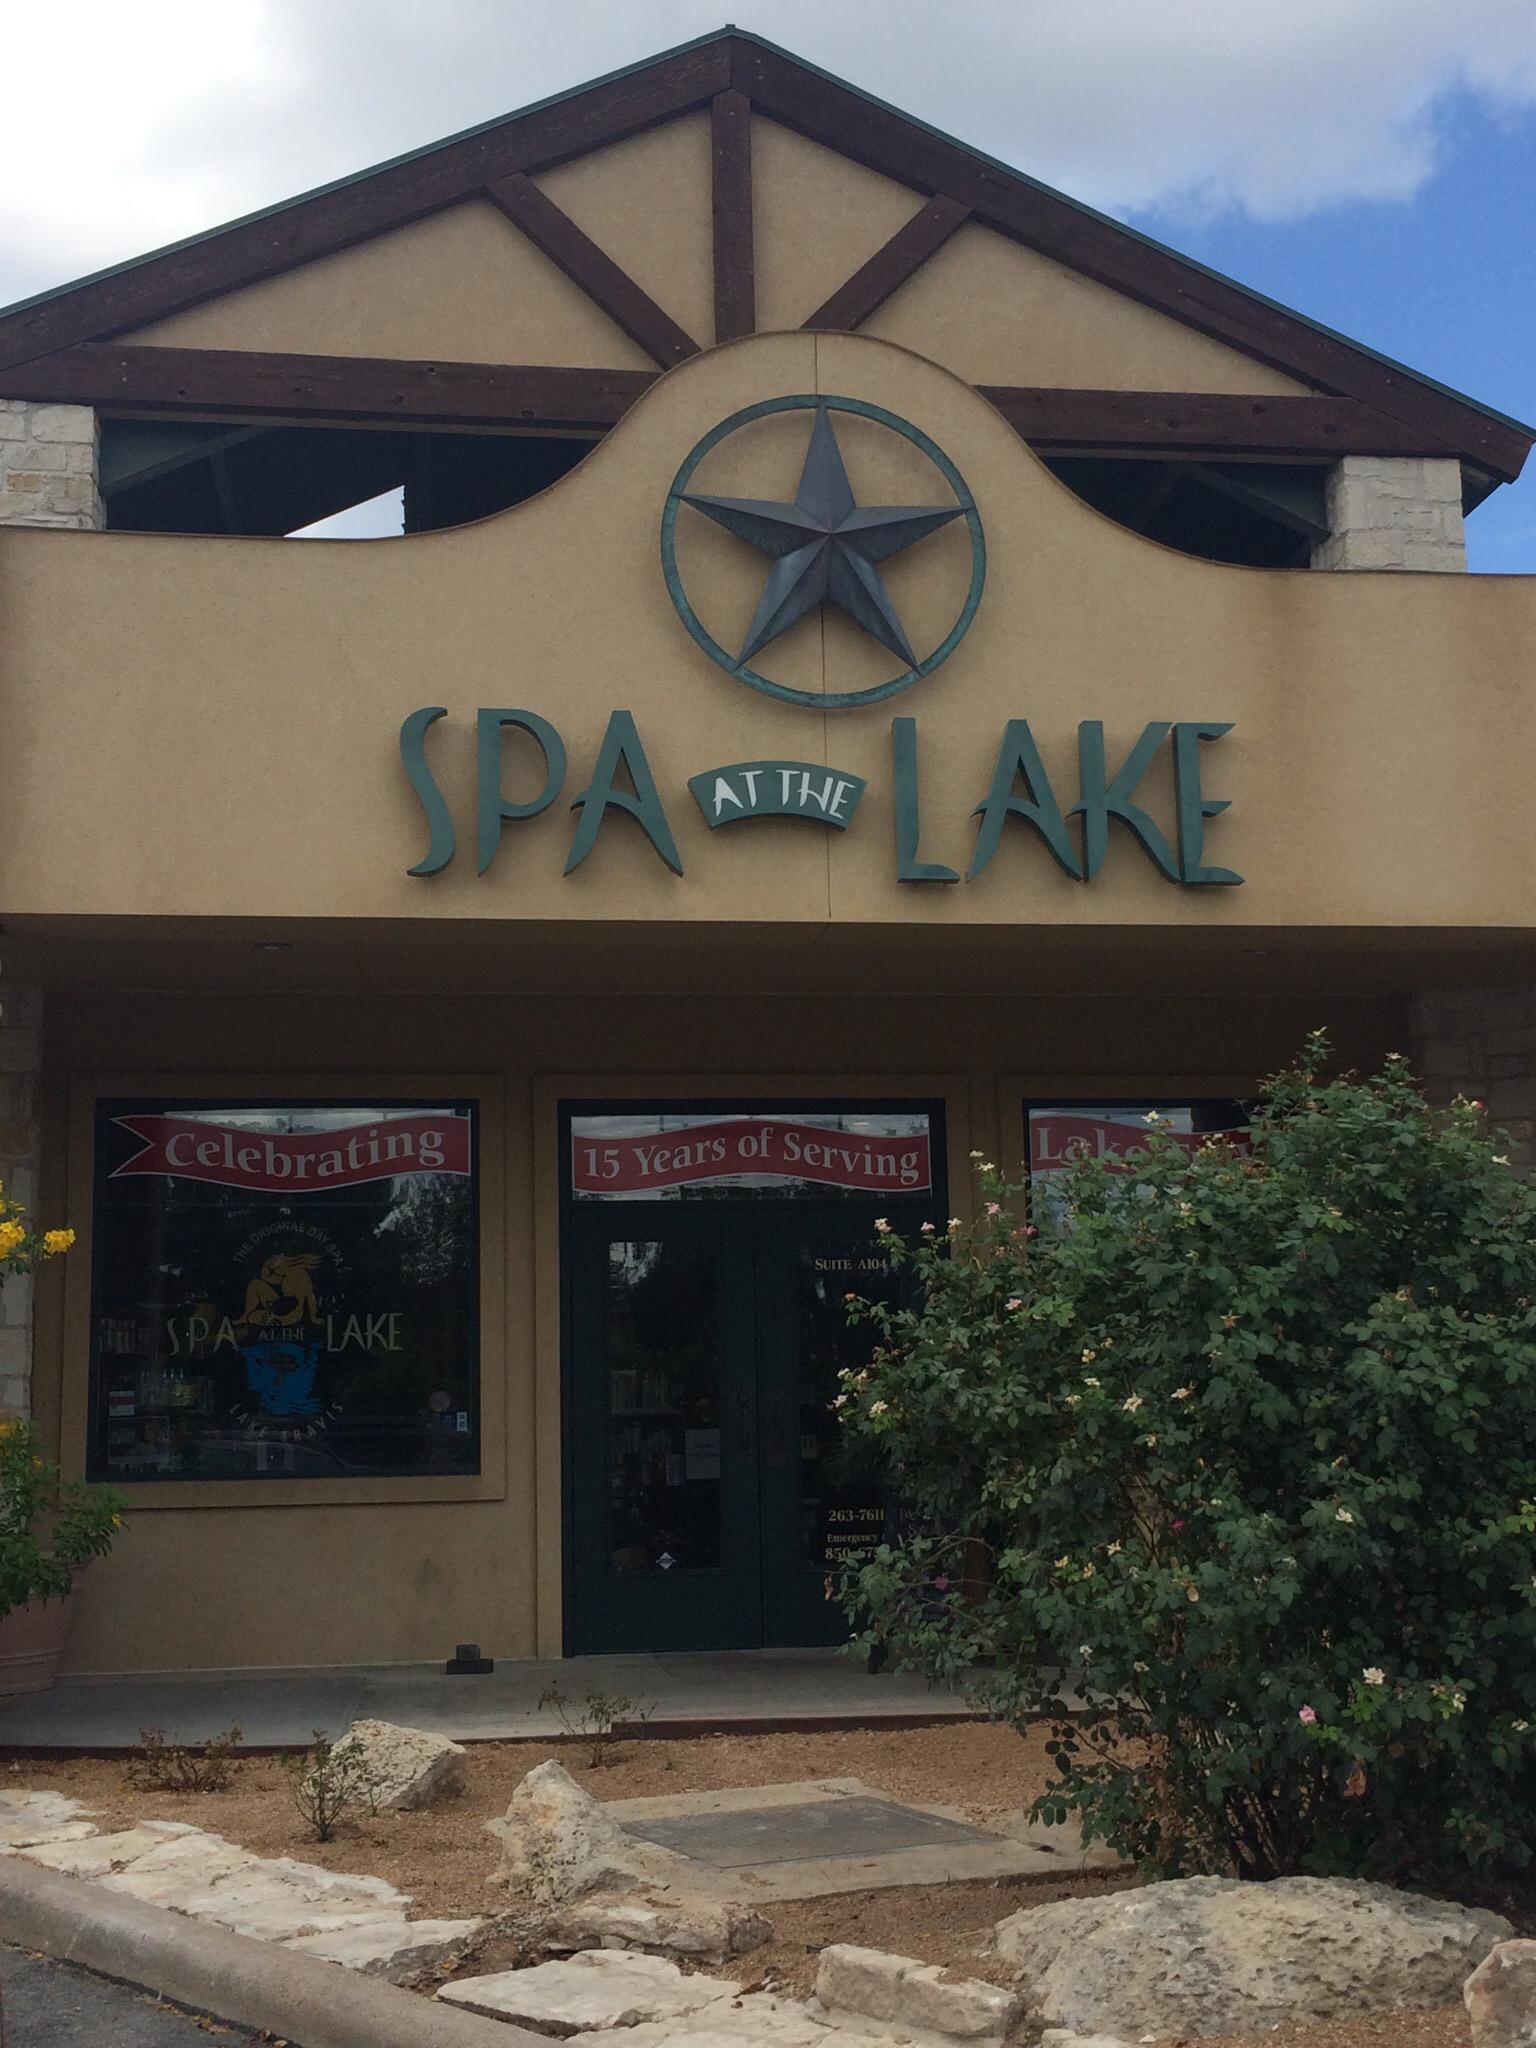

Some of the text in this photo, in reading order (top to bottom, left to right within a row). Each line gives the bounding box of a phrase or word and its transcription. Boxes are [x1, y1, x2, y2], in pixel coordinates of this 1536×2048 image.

[400, 706, 1246, 886] SPA AT THE LAKE
[165, 1127, 446, 1179] Celebrating
[584, 1127, 920, 1185] 15 Years of Serving
[232, 1221, 344, 1267] THE ORIGINAL DAY SPA
[815, 1258, 888, 1271] SUITE A104
[167, 1315, 240, 1355] SPA
[258, 1329, 277, 1341] AT
[327, 1312, 403, 1351] LAKE
[229, 1402, 343, 1441] LAKE TRAVIS
[828, 1508, 885, 1521] 263-7611
[826, 1532, 879, 1544] Emergency
